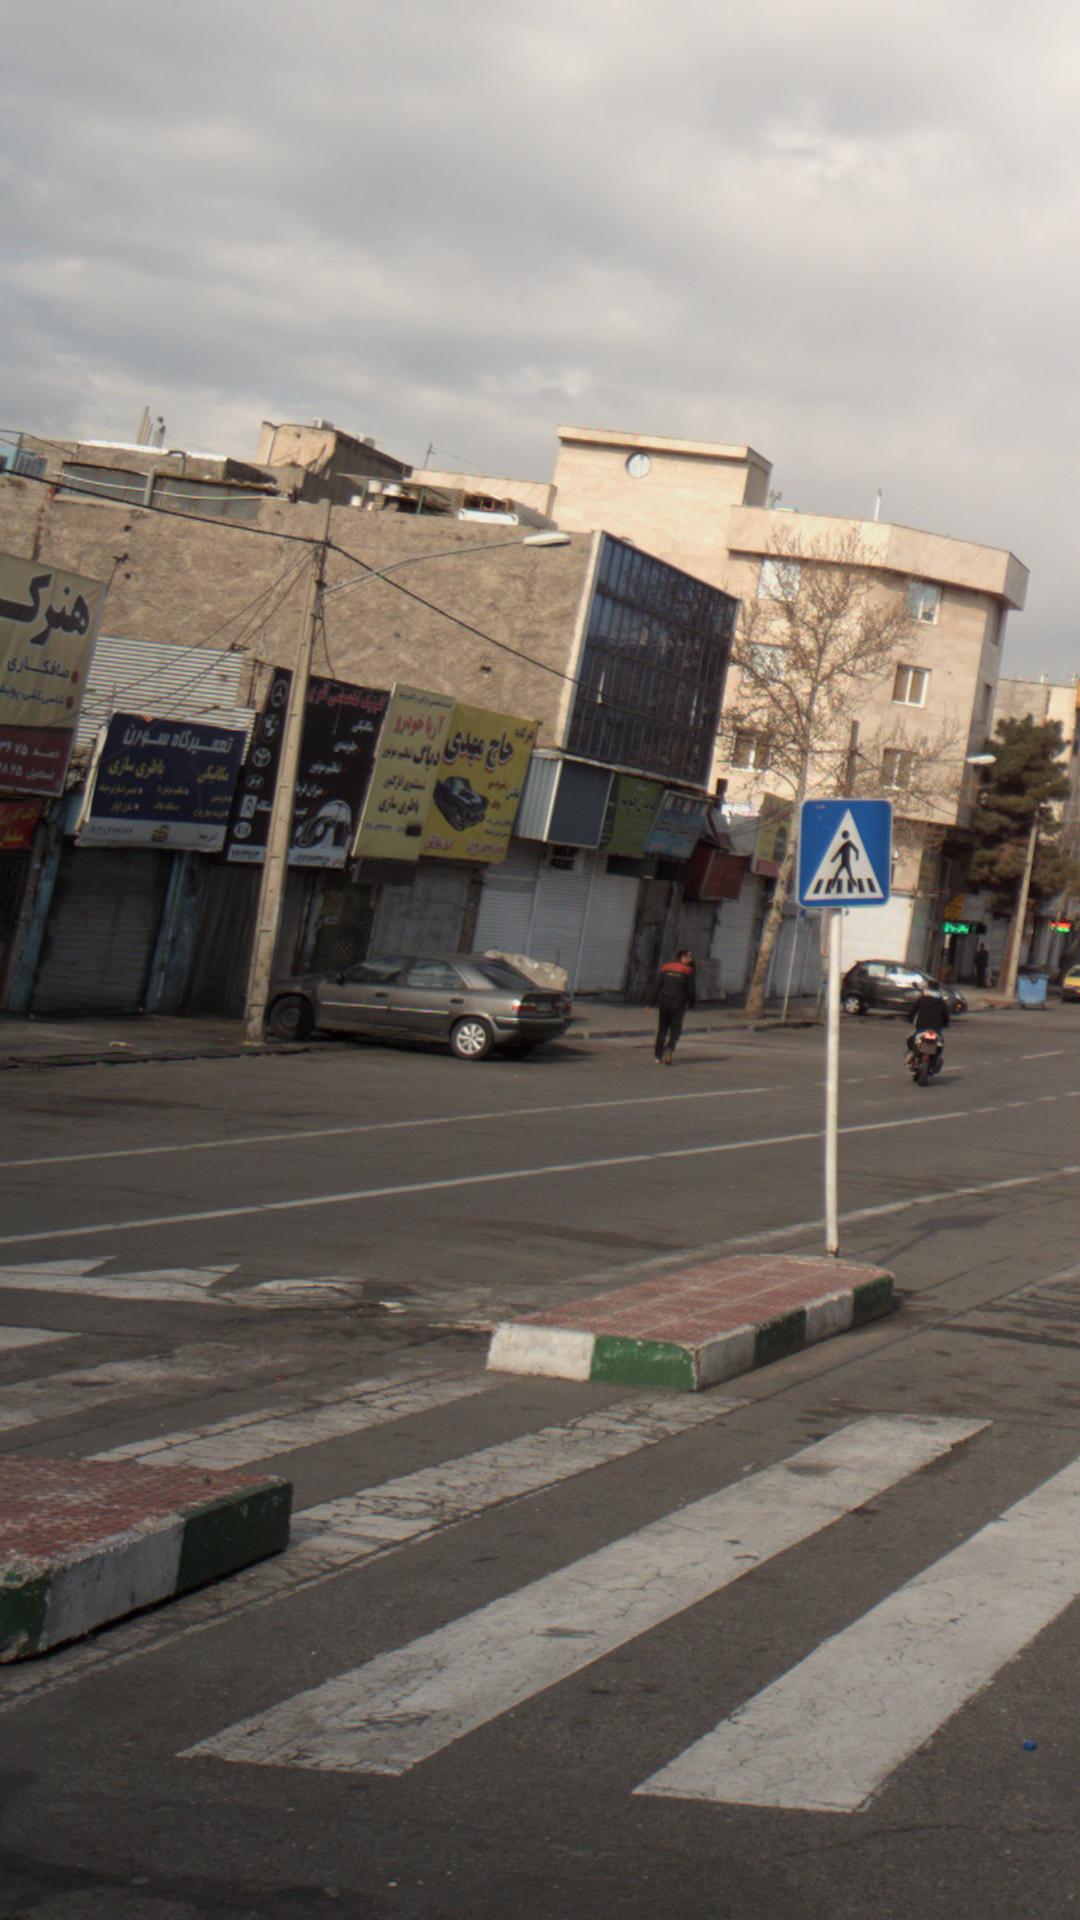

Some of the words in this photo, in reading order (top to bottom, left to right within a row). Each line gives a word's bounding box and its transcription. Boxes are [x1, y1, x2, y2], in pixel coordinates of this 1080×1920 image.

[122, 723, 170, 746] سورن
[171, 729, 235, 755] تعمیرگاه
[485, 731, 514, 773] حاج
[135, 757, 166, 780] باطری
